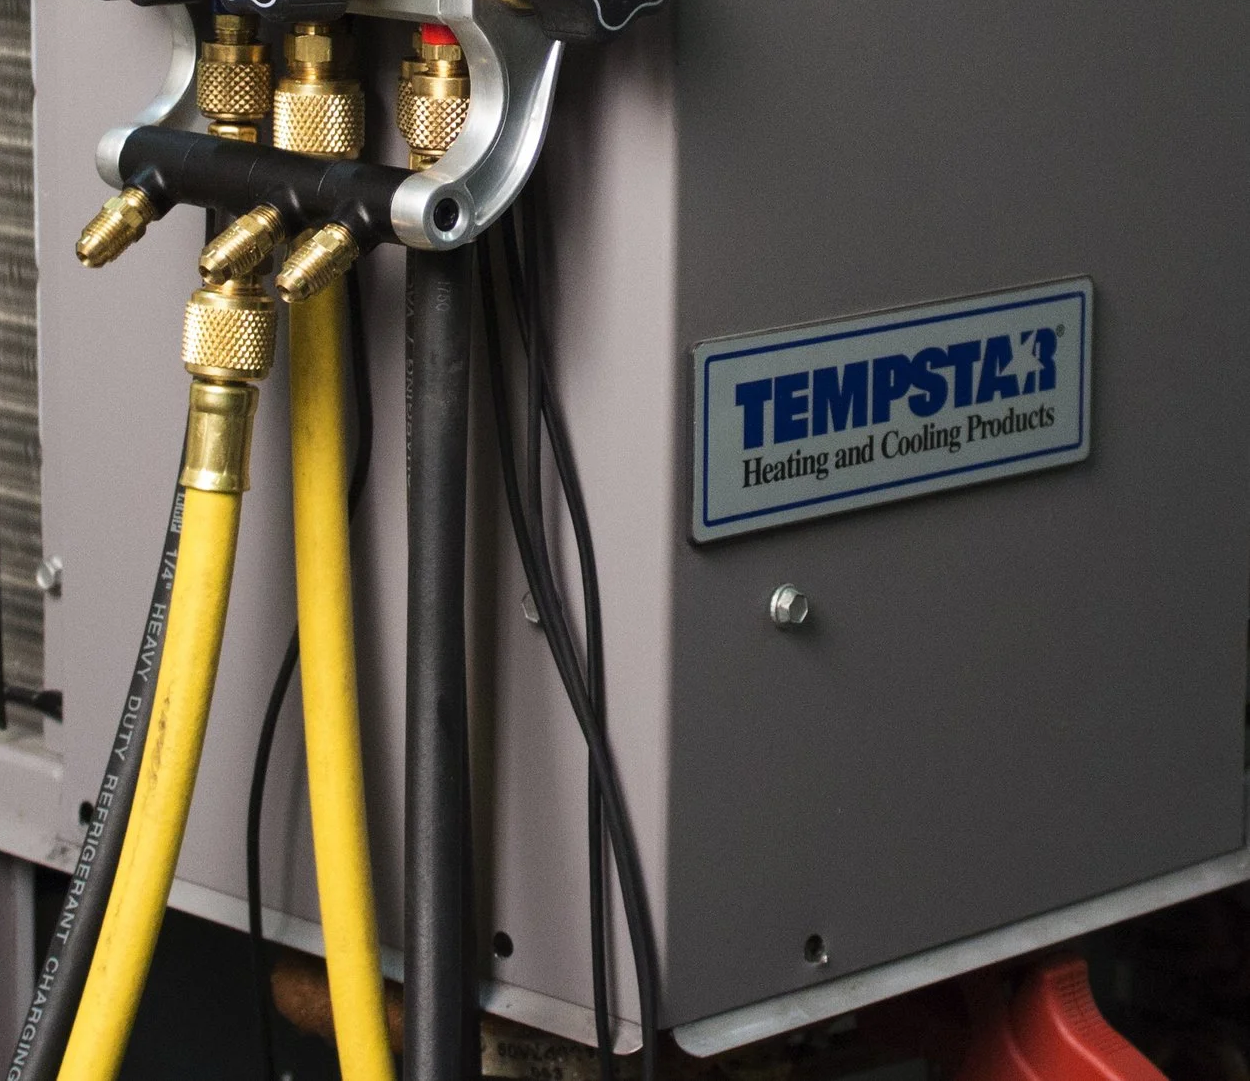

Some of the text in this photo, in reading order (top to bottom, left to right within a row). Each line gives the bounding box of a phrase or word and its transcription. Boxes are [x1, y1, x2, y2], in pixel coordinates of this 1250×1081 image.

[735, 326, 1058, 450] TEMPSTAR
[742, 403, 1056, 489] Heating and Cooling Products
[136, 602, 167, 683] HEAVY
[114, 696, 143, 761] DUTY
[54, 774, 119, 945] REFRIGERANT
[6, 956, 60, 1081] CHARGING
